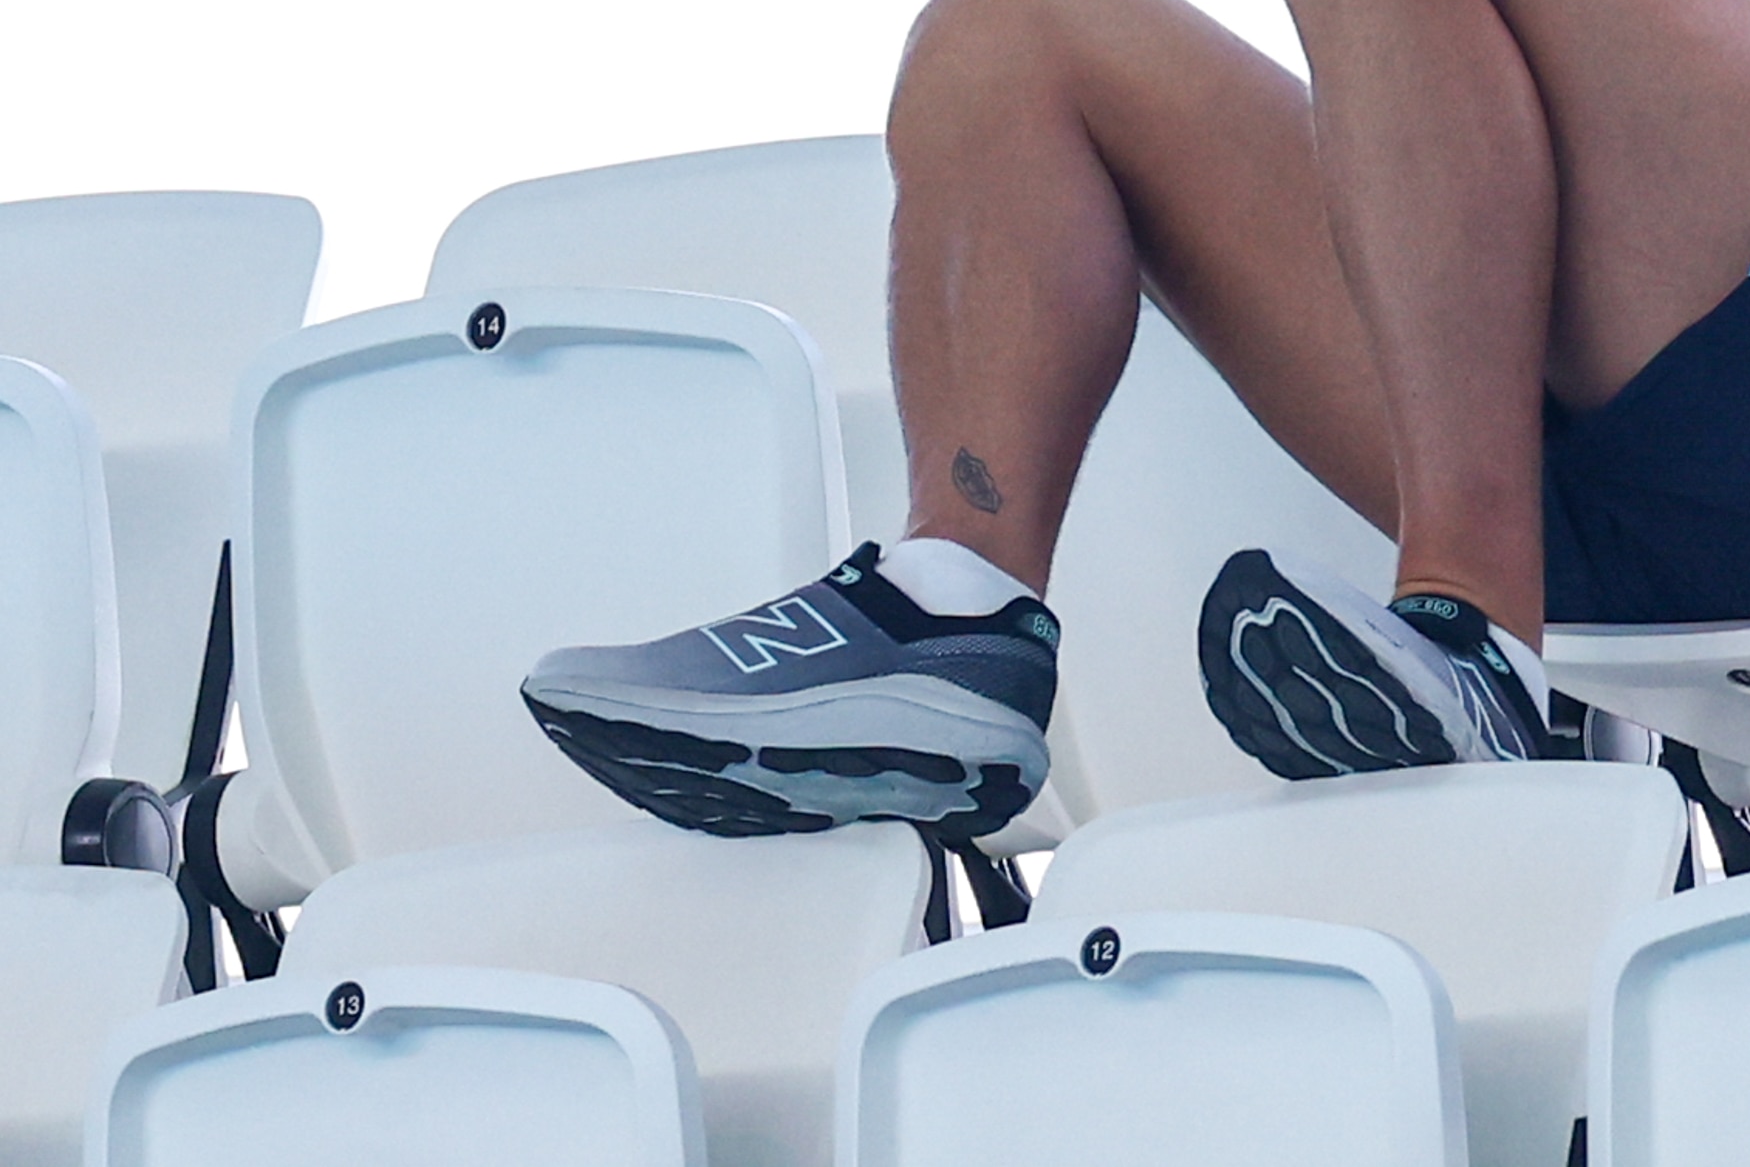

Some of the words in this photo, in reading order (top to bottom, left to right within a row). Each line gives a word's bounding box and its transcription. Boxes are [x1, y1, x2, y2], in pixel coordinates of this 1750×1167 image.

[477, 316, 500, 336] 14
[700, 595, 848, 673] N
[1090, 940, 1115, 961] 12
[336, 996, 359, 1016] 13
